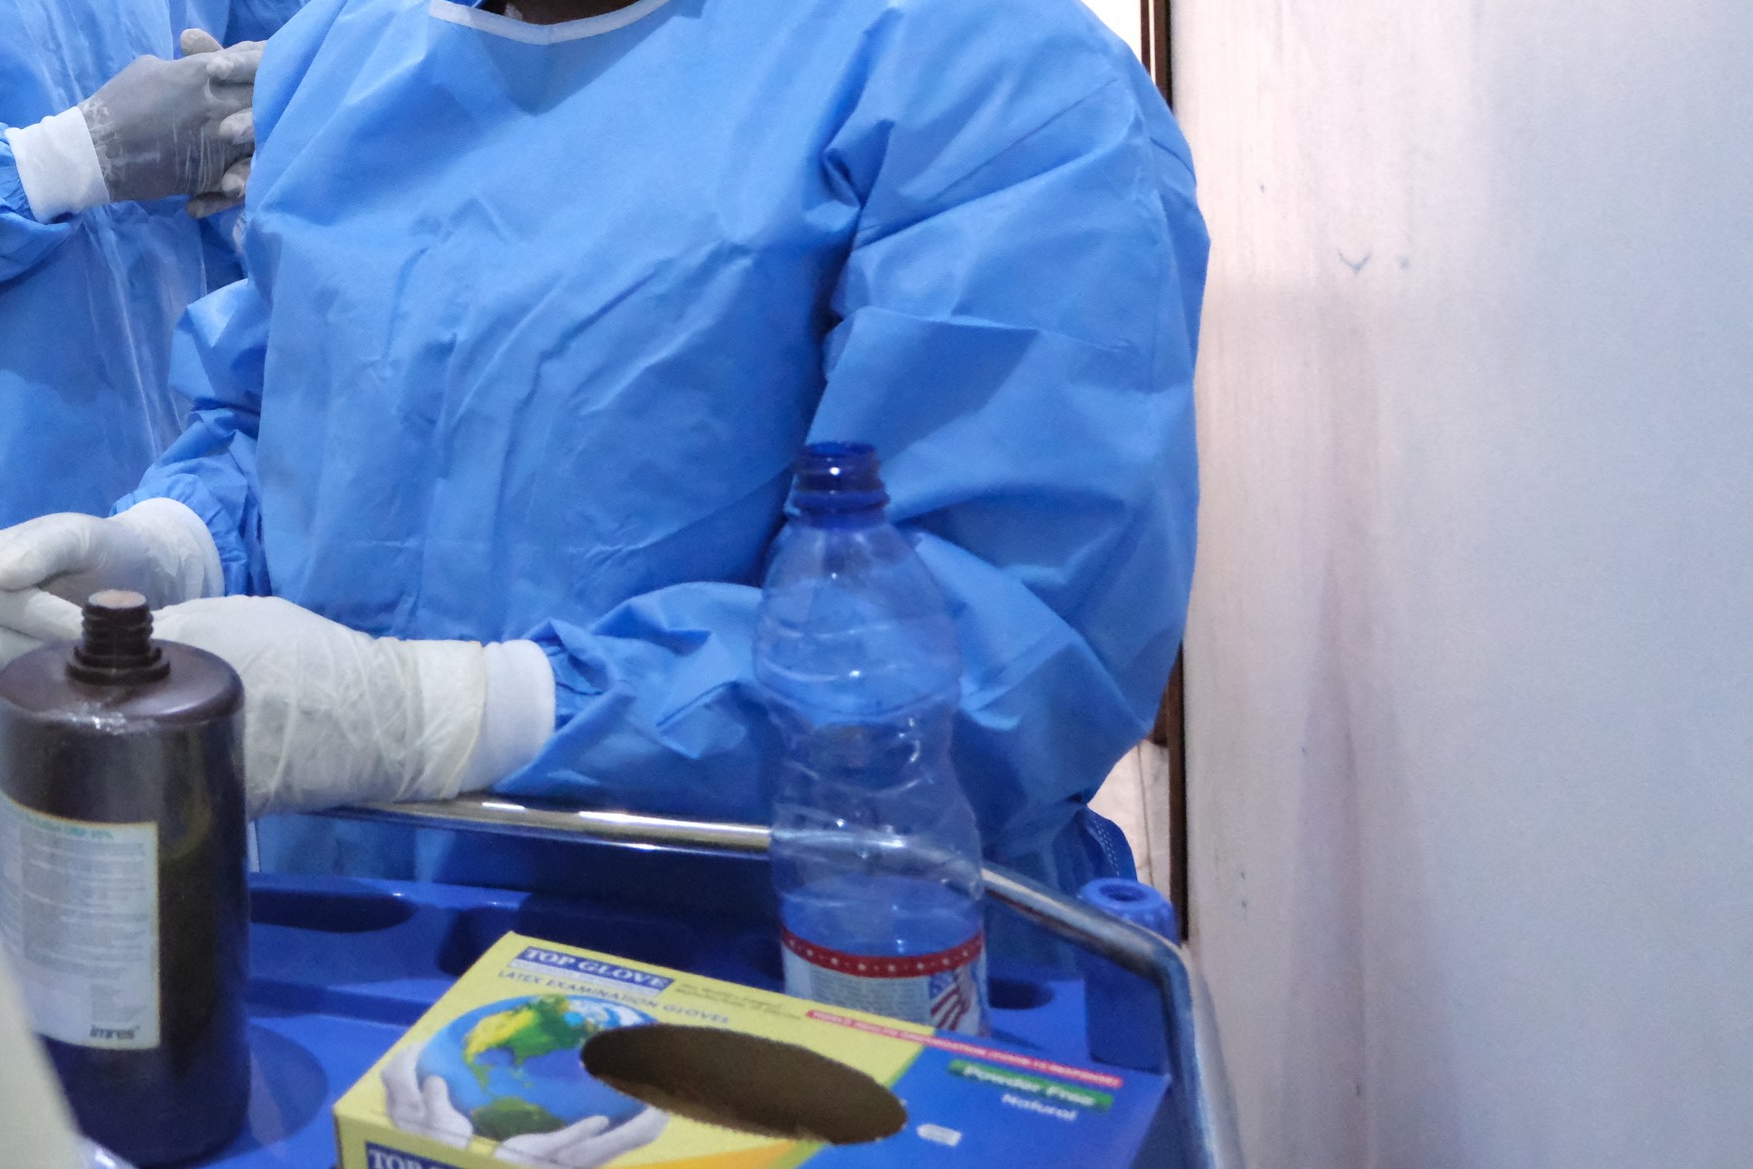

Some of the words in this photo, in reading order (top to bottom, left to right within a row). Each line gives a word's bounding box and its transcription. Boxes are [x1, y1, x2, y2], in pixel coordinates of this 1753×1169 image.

[525, 948, 575, 966] TOP
[578, 961, 670, 988] GLOVE
[498, 970, 541, 984] LATEX
[546, 979, 659, 1008] EXAMINATION
[663, 1004, 730, 1024] GLOVES
[1002, 1092, 1077, 1121] Natural
